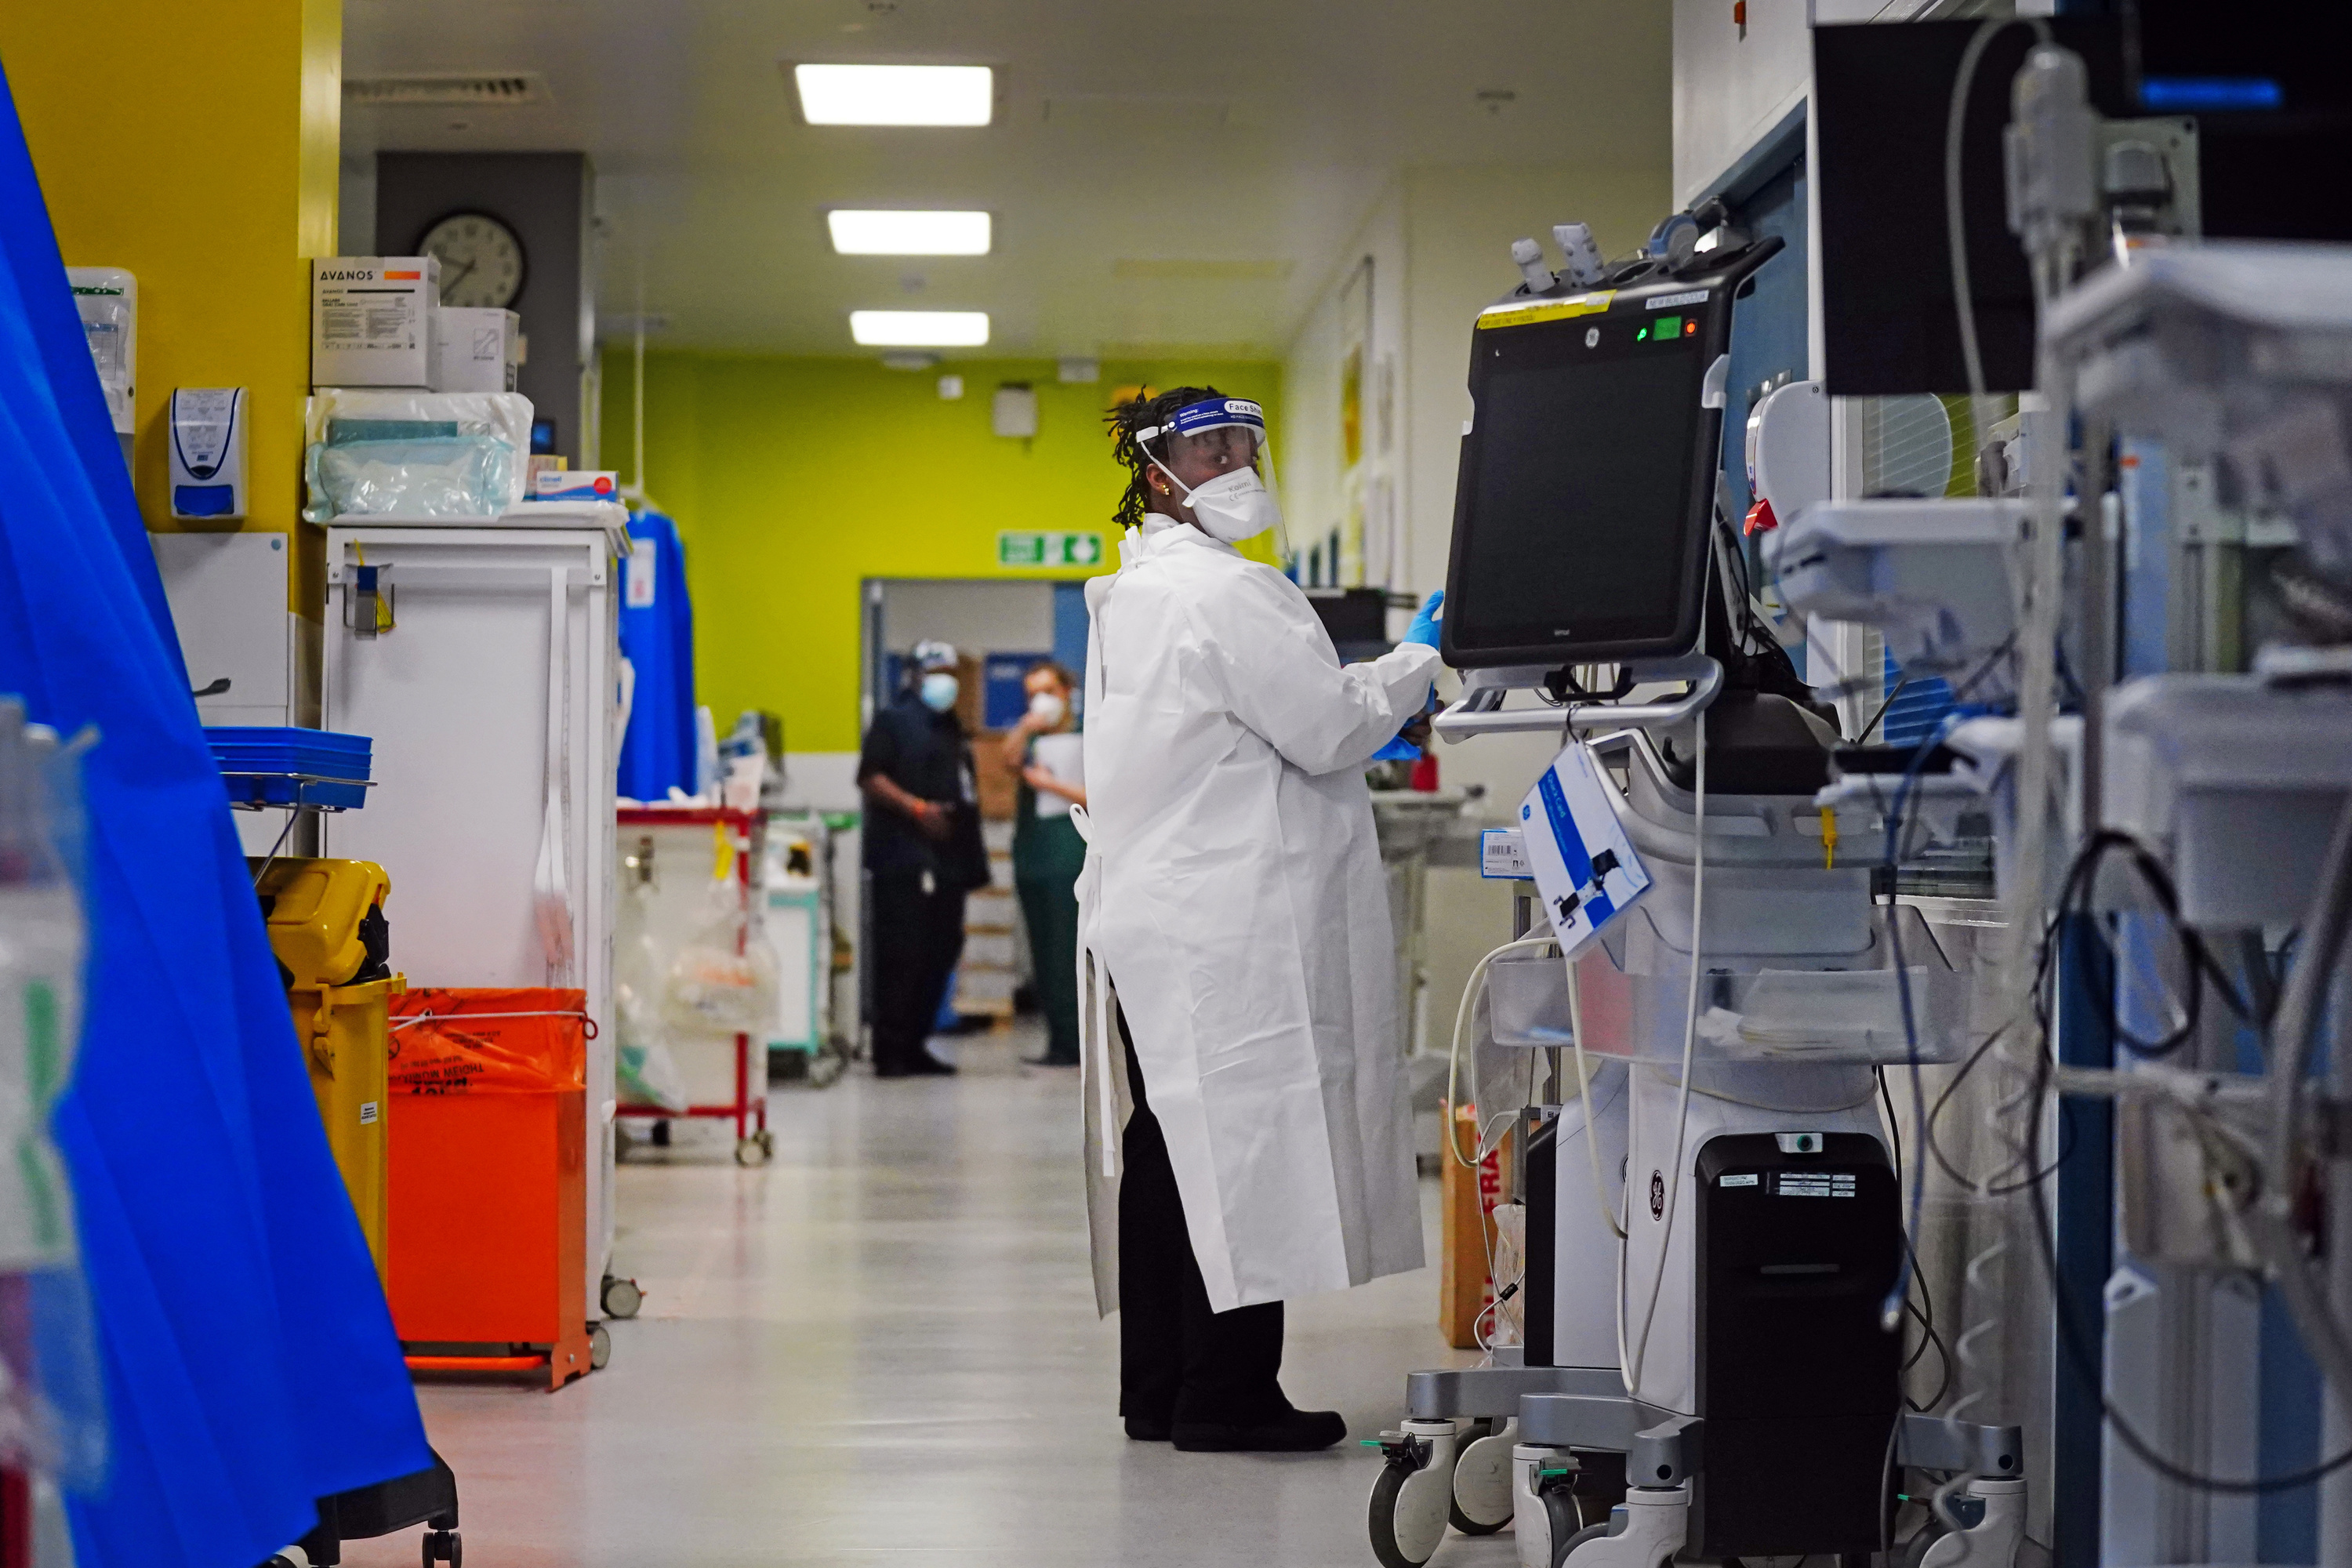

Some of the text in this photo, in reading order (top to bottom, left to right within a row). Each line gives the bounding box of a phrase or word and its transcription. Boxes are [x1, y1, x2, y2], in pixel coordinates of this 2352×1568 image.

[320, 270, 374, 281] AVANOS
[1229, 403, 1249, 412] Face
[1228, 478, 1252, 492] Kolmi
